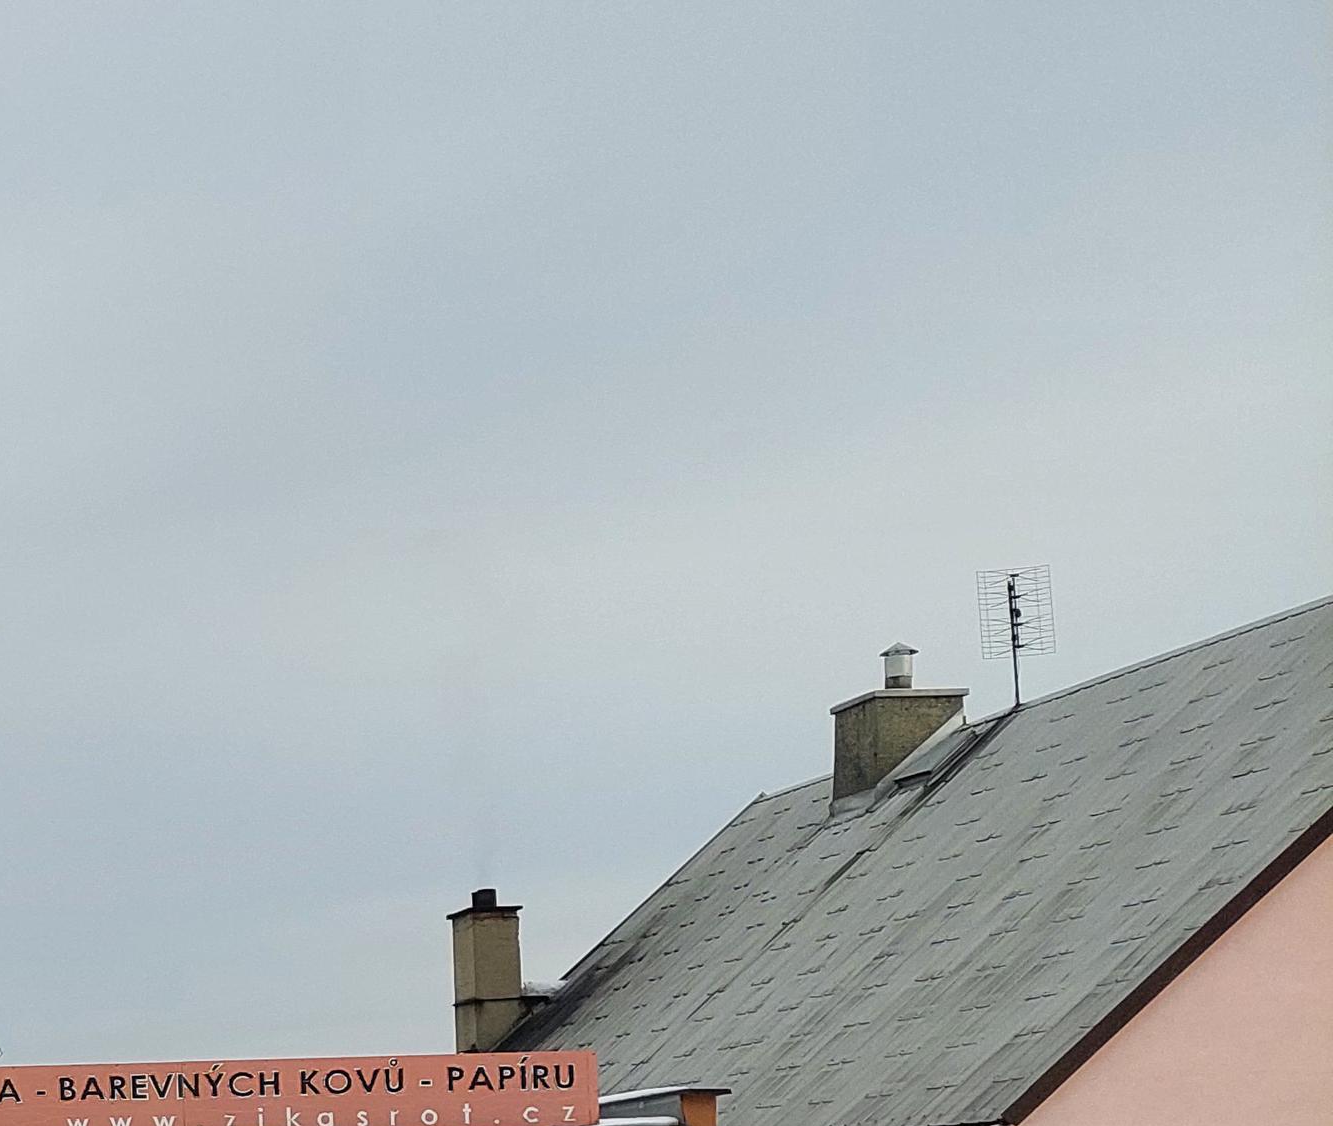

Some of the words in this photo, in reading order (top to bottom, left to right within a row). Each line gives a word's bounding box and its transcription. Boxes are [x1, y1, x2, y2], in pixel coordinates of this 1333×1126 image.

[58, 1063, 281, 1102] BAREVNÝCH
[299, 1058, 404, 1095] KOVŮ
[446, 1056, 576, 1092] PAPÍRU
